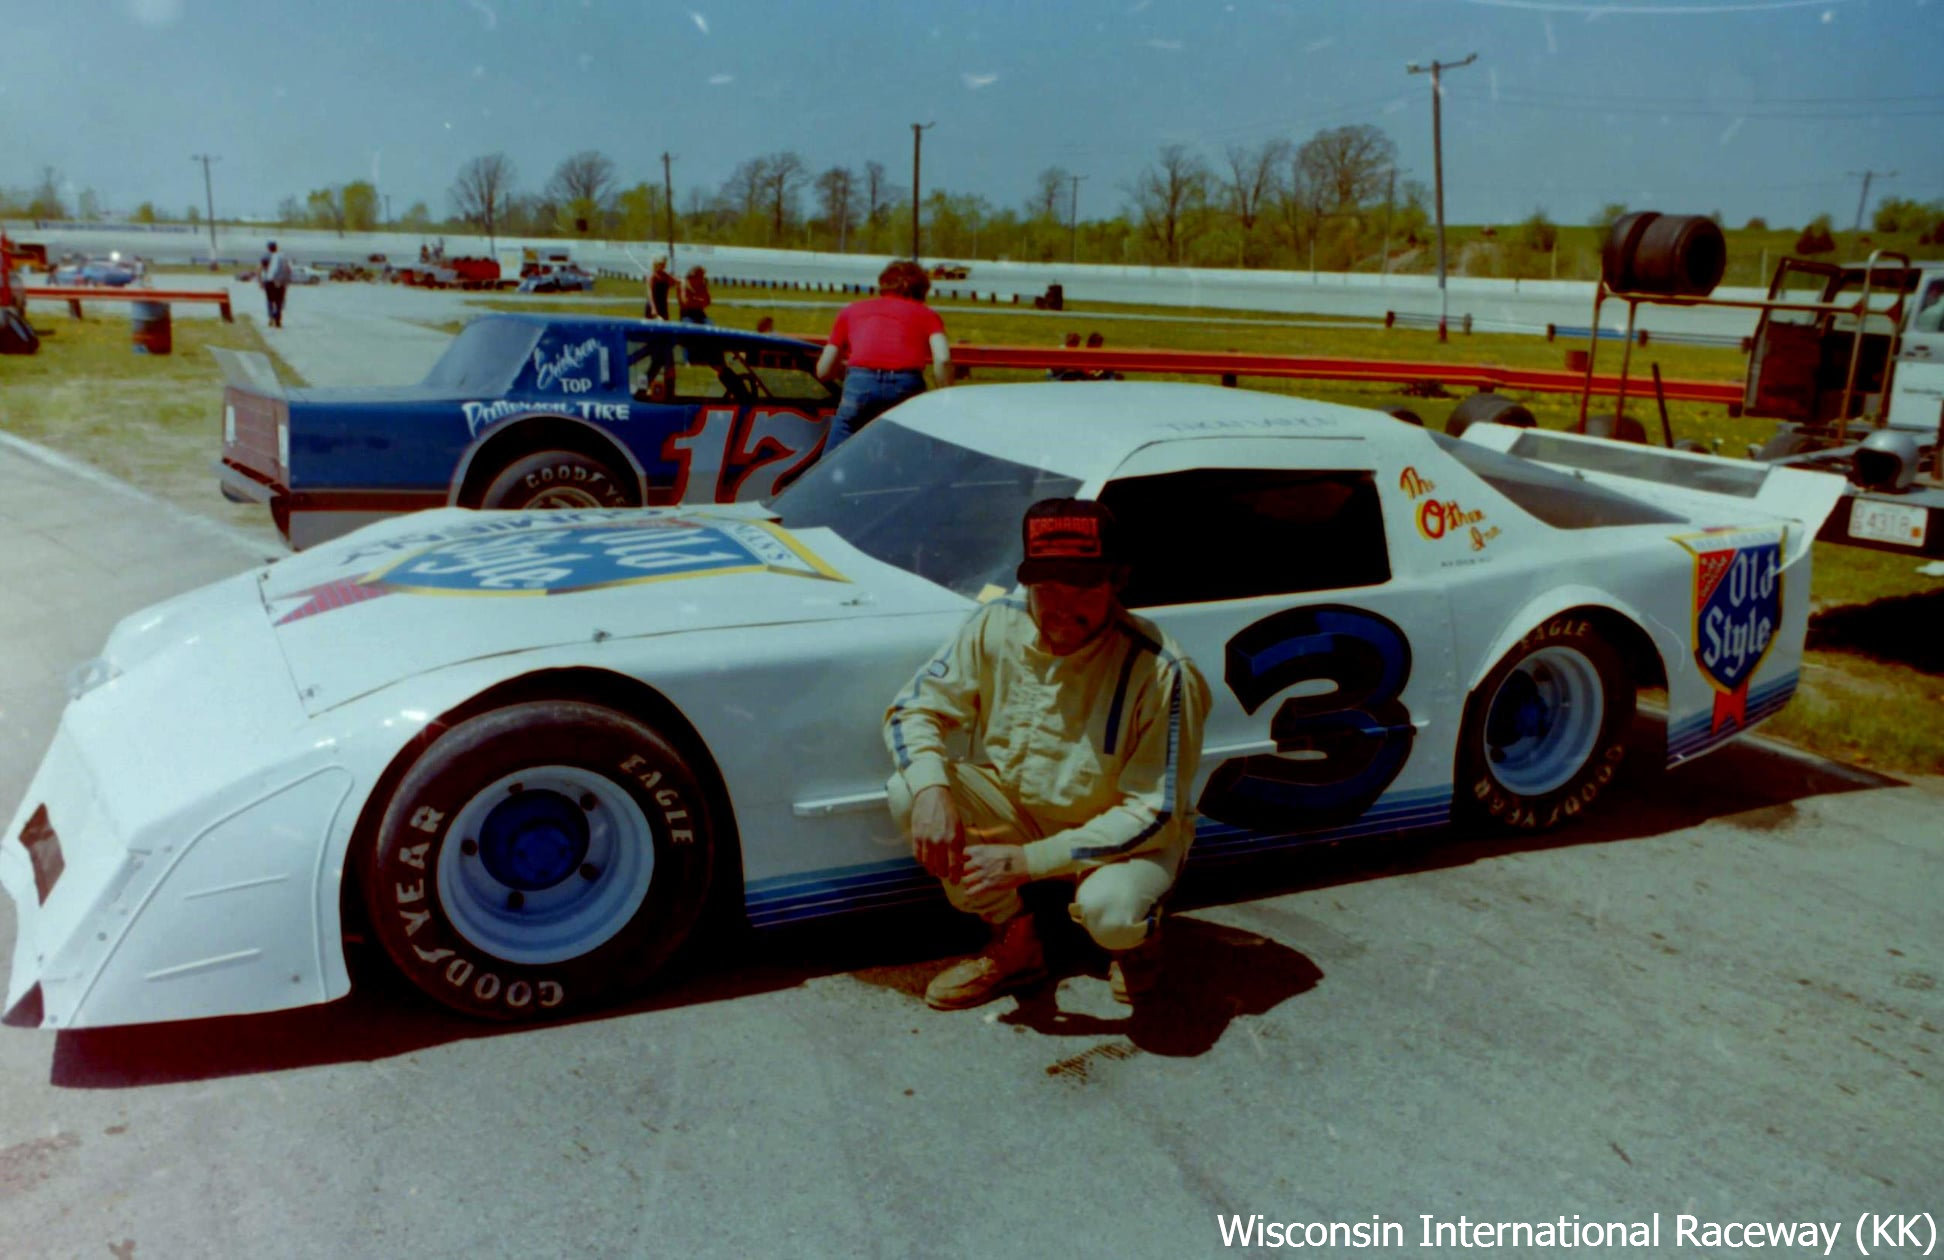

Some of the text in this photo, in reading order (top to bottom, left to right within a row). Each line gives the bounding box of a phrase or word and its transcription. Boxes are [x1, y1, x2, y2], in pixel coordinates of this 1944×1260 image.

[560, 377, 592, 393] TOP
[525, 464, 626, 505] GOODYE
[660, 404, 836, 506] 17
[1730, 550, 1778, 608] Old
[1519, 619, 1591, 651] EAGLE
[1703, 605, 1771, 678] Style
[1196, 603, 1416, 835] 3
[620, 753, 694, 844] EAGLE
[397, 806, 564, 1007] GOODYEAR
